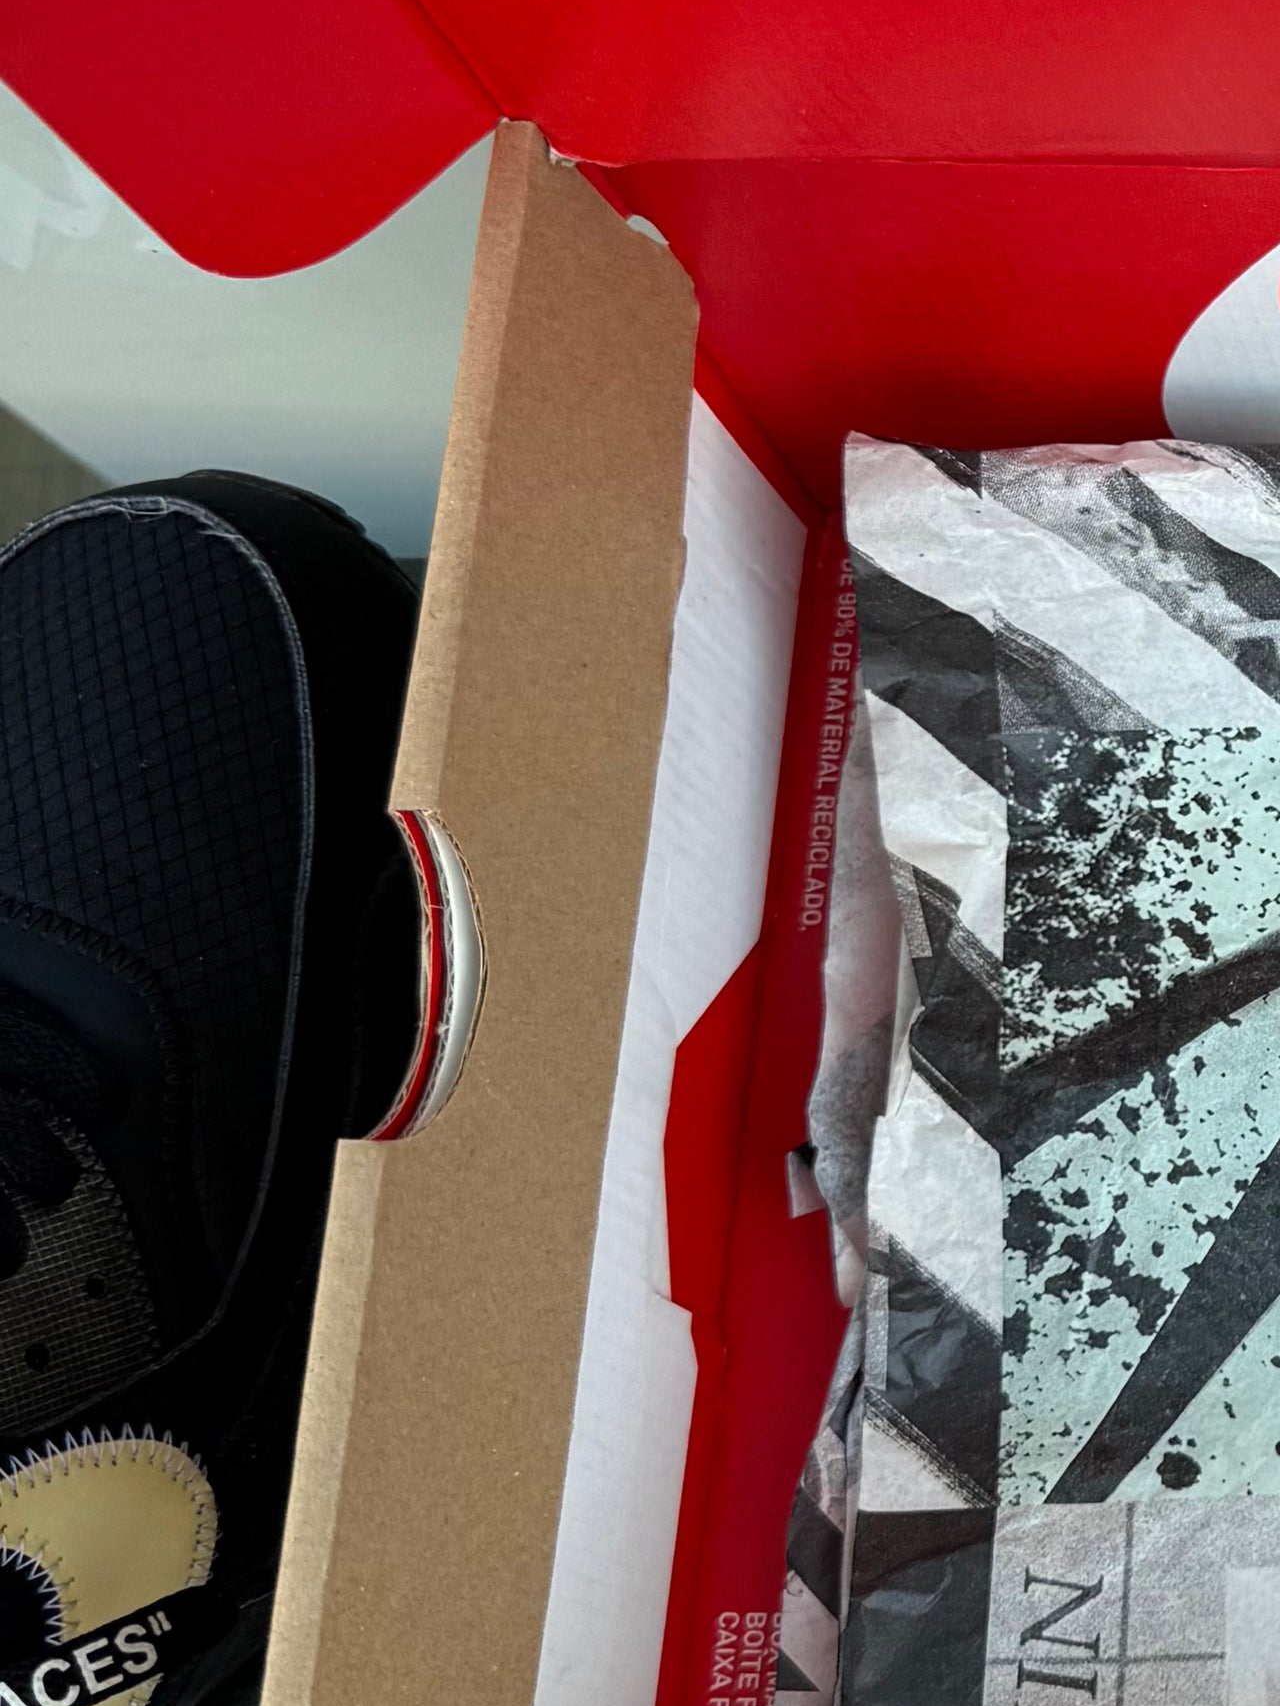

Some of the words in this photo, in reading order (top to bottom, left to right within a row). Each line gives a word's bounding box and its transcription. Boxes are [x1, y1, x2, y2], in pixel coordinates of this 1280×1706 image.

[828, 641, 851, 671] DE
[814, 676, 847, 790] MATERIAL
[710, 1611, 741, 1691] CAIXA
[737, 1611, 767, 1691] BOÎTE
